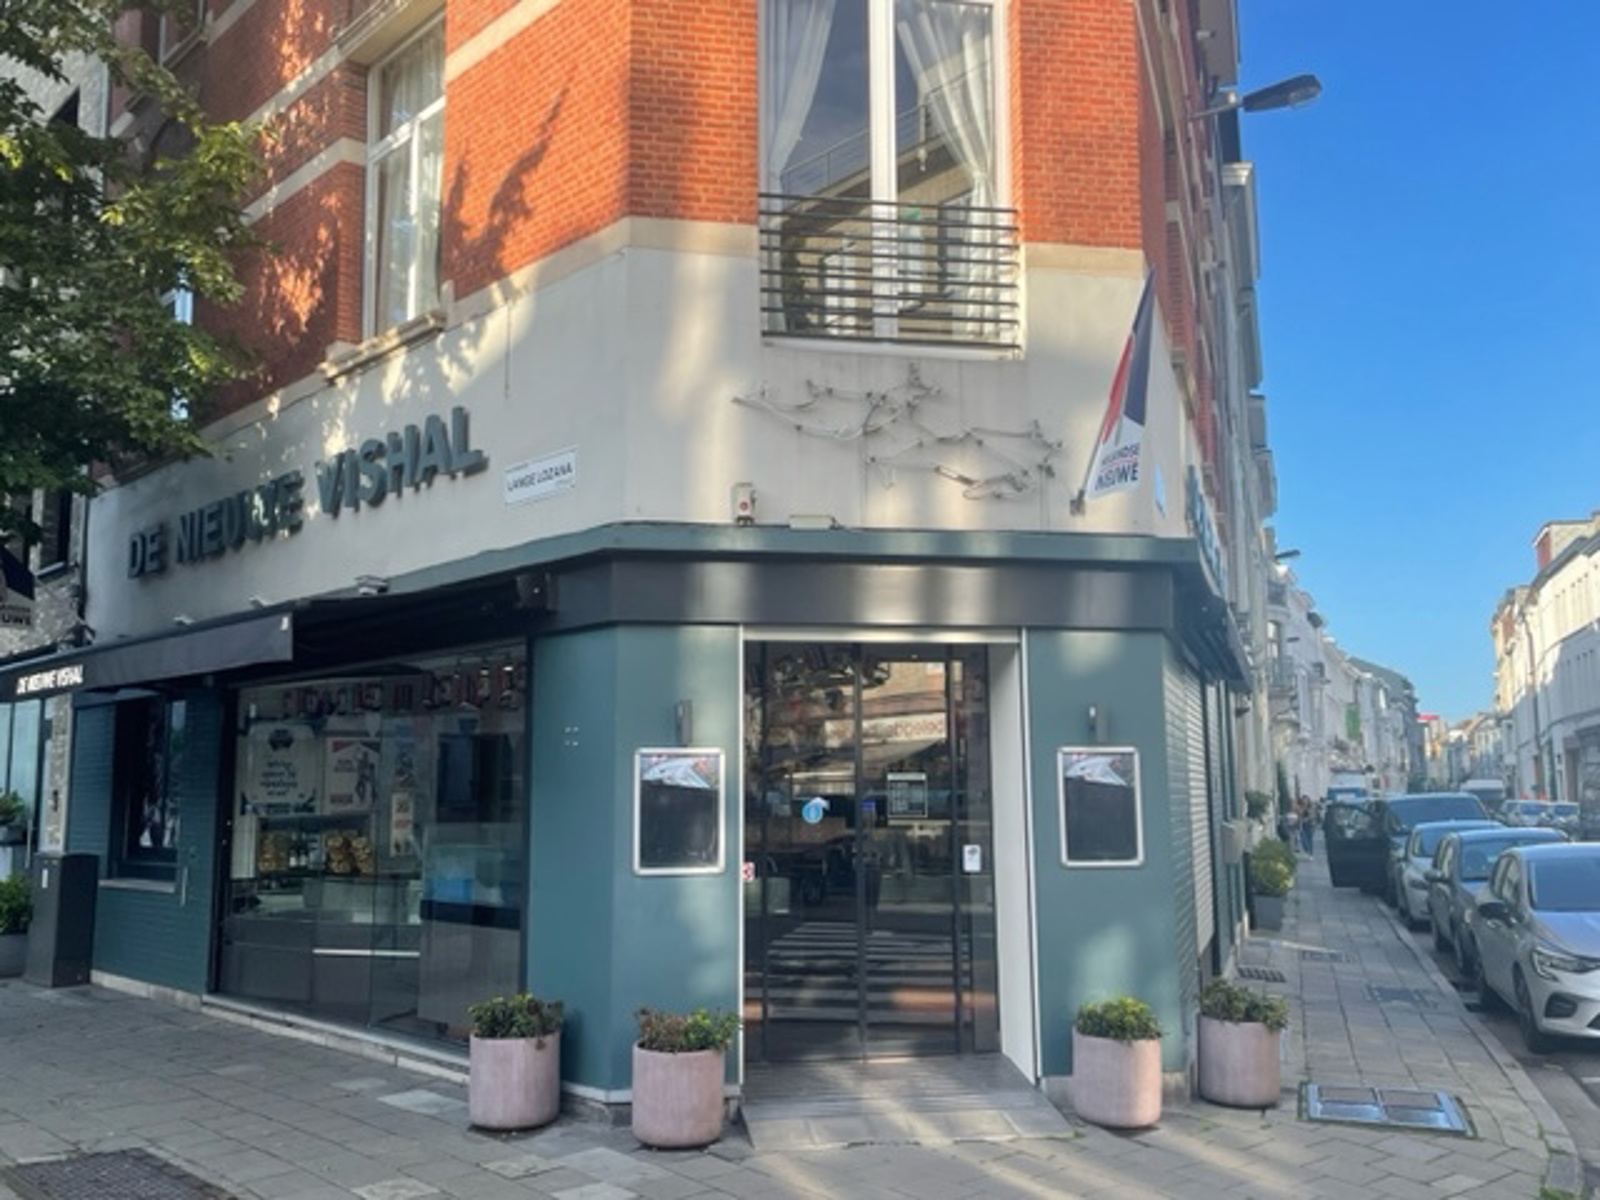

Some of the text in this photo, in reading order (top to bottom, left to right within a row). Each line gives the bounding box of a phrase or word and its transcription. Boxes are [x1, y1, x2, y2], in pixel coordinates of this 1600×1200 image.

[127, 405, 489, 580] DE NIEUWE VISHAL
